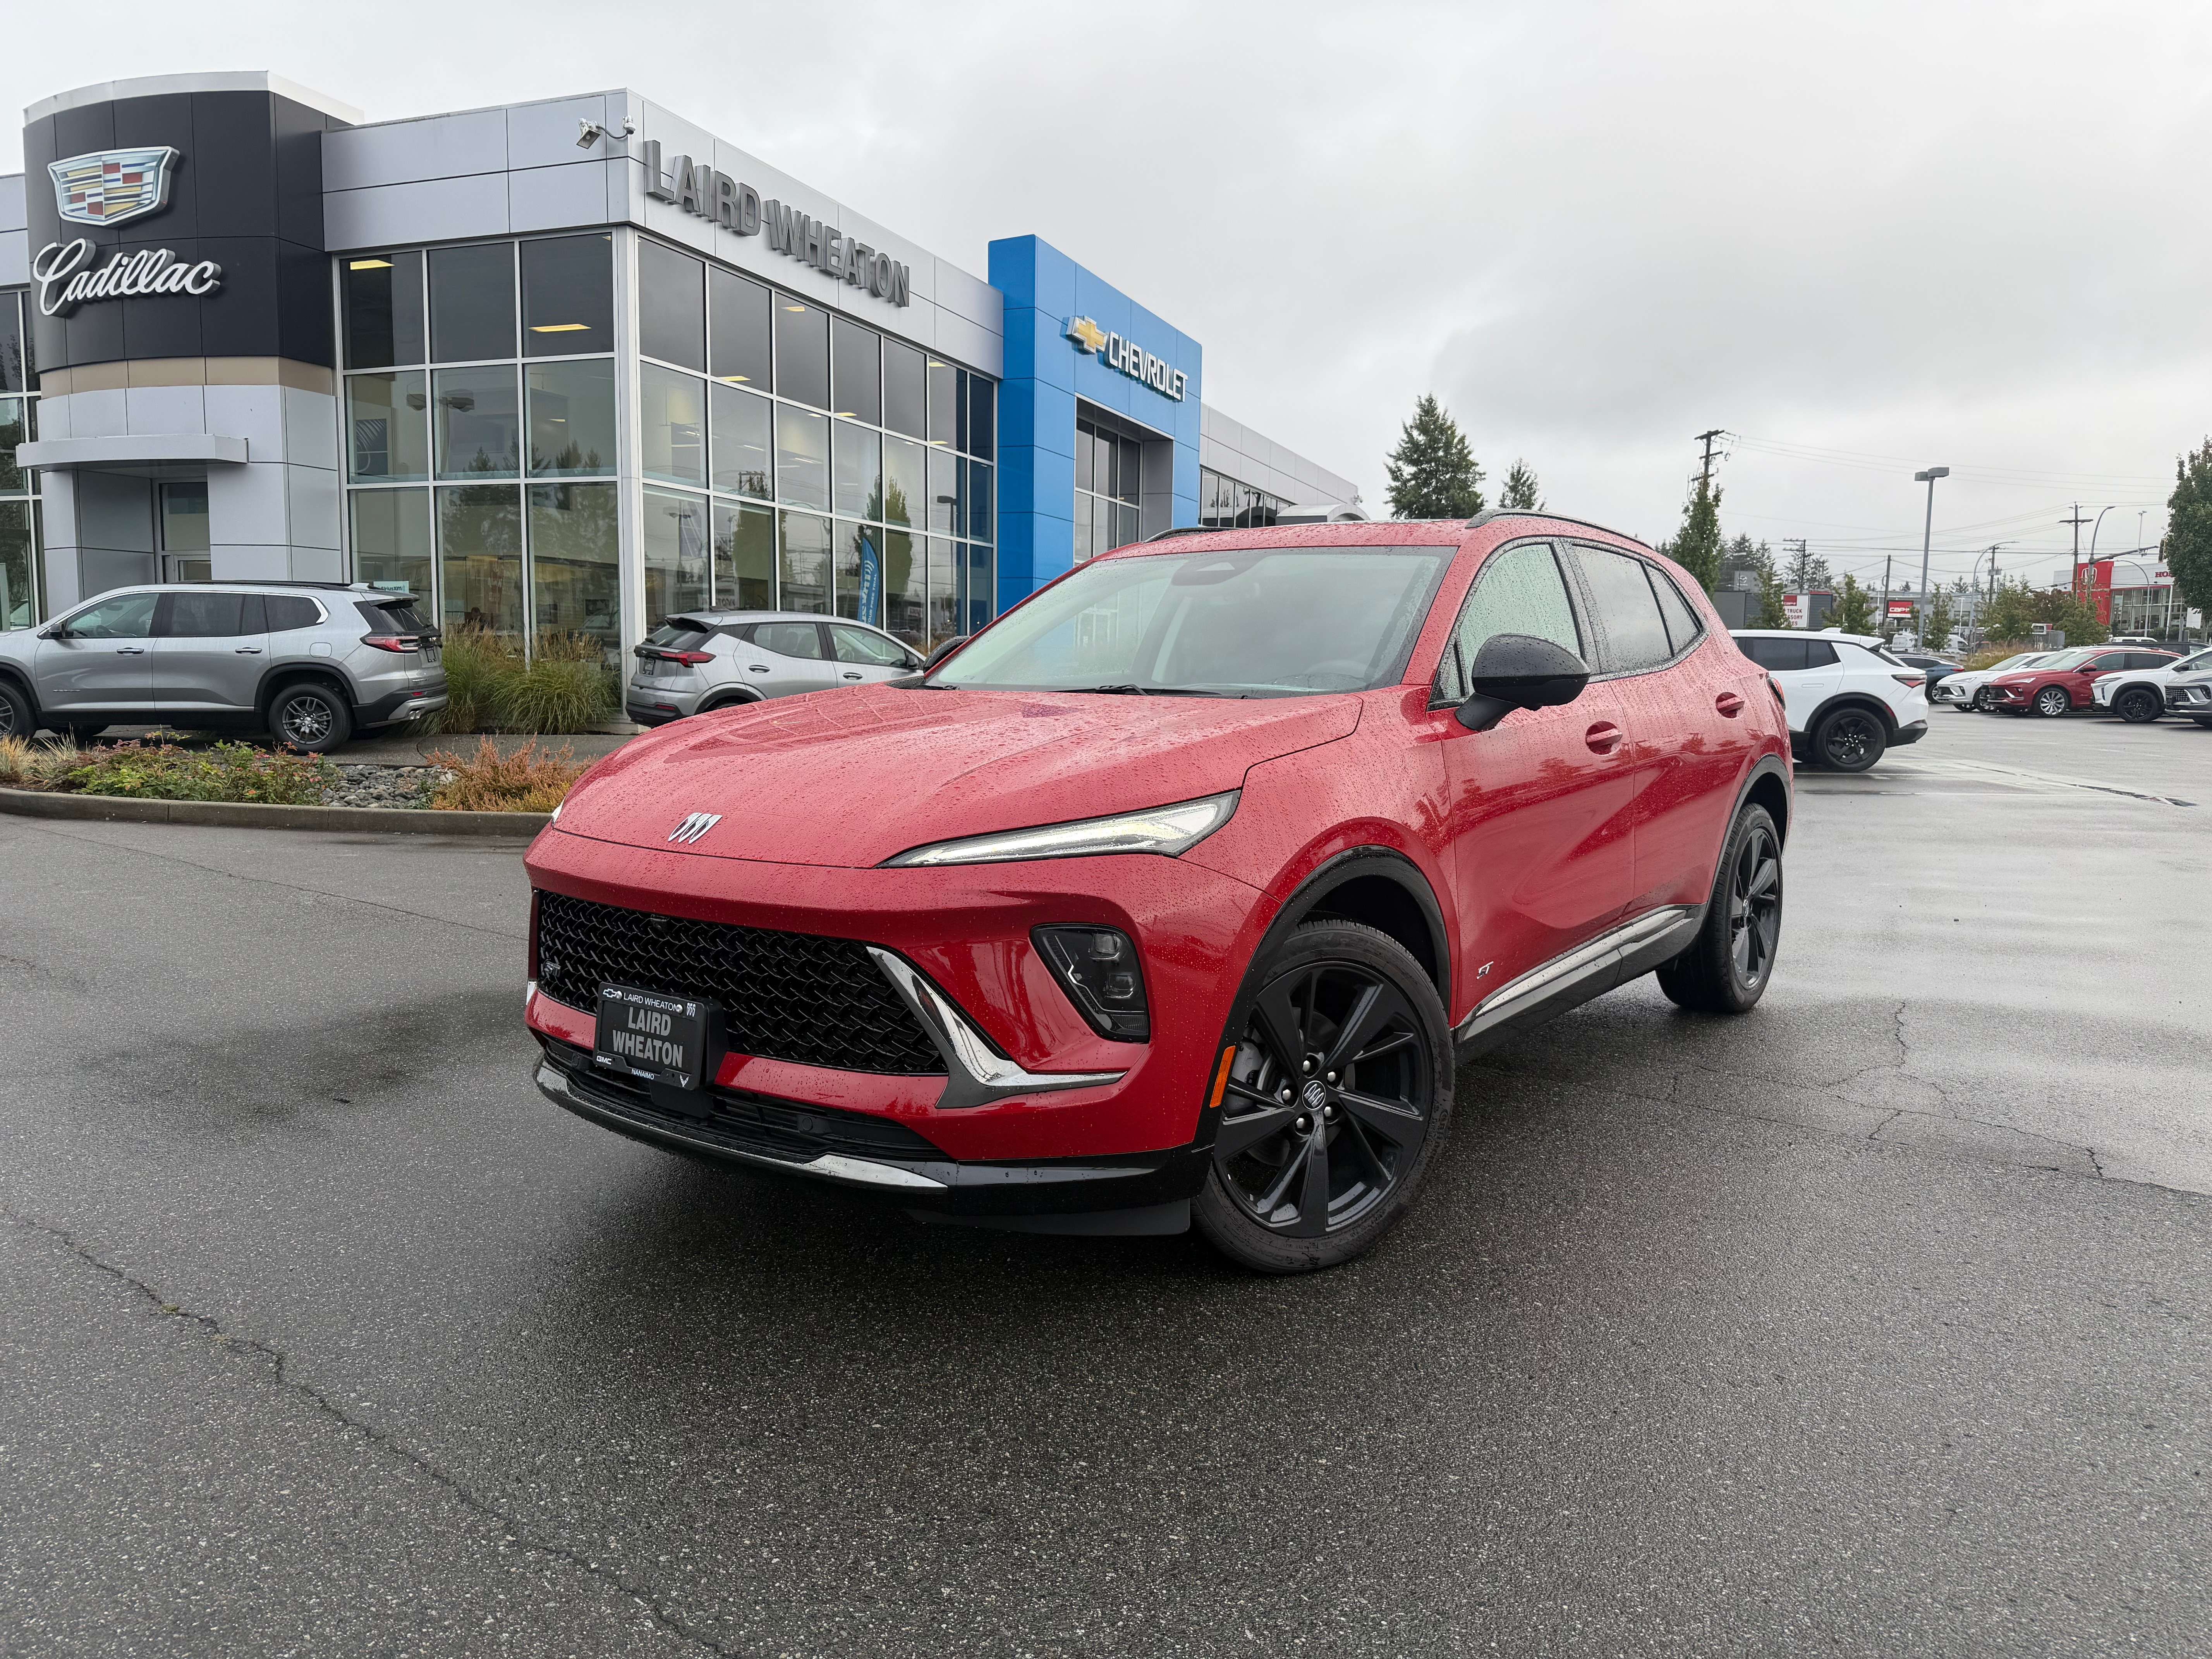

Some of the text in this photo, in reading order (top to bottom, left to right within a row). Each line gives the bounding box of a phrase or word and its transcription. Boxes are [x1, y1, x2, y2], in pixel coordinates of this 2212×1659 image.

[645, 139, 909, 307] LAIRD WHEATON
[33, 238, 218, 316] Cadillac
[1109, 331, 1188, 402] CHEVROLET
[623, 992, 677, 1011] LAIRD WHEATON
[628, 1006, 671, 1036] LAIRD
[596, 1055, 612, 1065] GMC
[613, 1029, 683, 1068] WHEATON
[631, 1068, 654, 1080] NANAIMO
